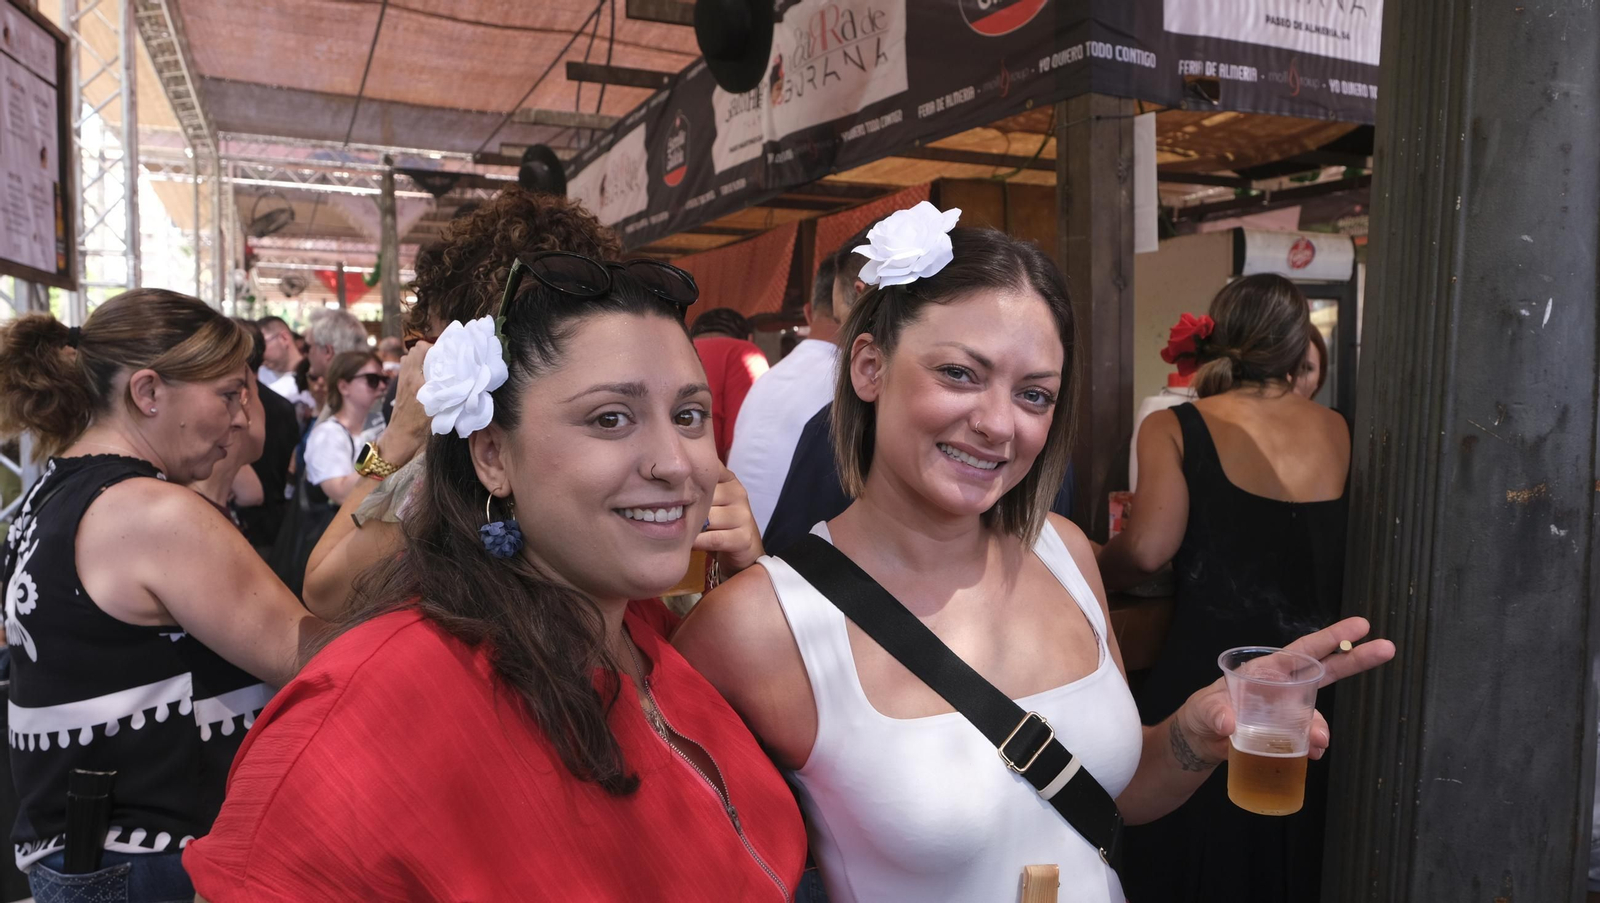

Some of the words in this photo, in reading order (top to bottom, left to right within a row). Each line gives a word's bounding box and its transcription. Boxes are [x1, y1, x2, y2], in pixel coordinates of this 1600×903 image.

[861, 6, 887, 35] de
[1265, 14, 1291, 29] PASEO
[1293, 20, 1303, 31] DE
[918, 100, 936, 118] FERIA
[936, 96, 945, 113] DE
[945, 85, 975, 108] ALMERIA
[1039, 56, 1051, 74] YO
[1051, 44, 1084, 69] QUIERO
[1085, 40, 1113, 60] TODO
[1115, 45, 1157, 69] CONTIGO
[1178, 59, 1204, 76] FERIA
[1205, 60, 1218, 77] DE
[1219, 62, 1258, 83] ALMERIA
[1328, 78, 1341, 94] YO
[1341, 80, 1369, 99] QUIERO
